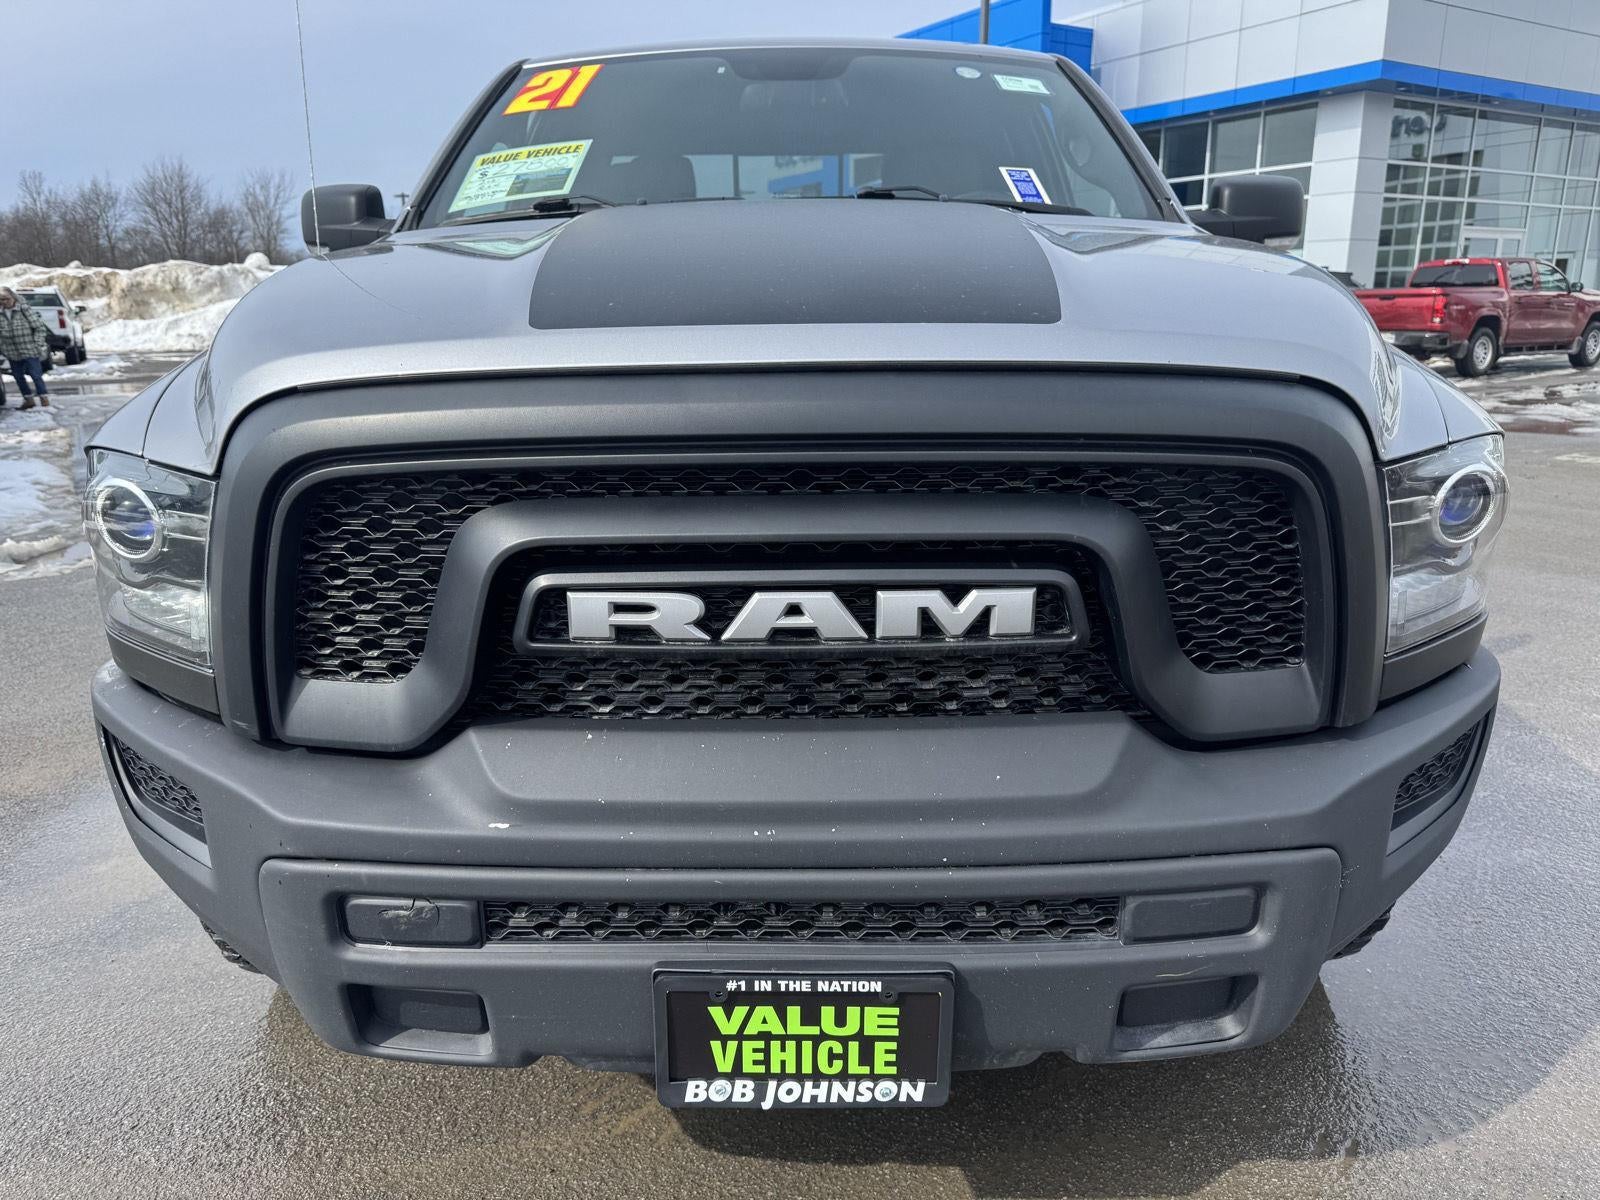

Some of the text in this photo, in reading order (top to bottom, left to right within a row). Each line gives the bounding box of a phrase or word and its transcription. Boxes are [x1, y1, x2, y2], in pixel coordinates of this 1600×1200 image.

[502, 64, 605, 115] 21
[479, 144, 584, 166] VALUE VEHICLE
[566, 587, 1037, 641] RAM
[725, 980, 882, 993] #1 IN THE NATION
[707, 1005, 900, 1037] VALUE
[709, 1040, 898, 1075] VEHICLE
[684, 1079, 926, 1110] BOB JOHNSON
